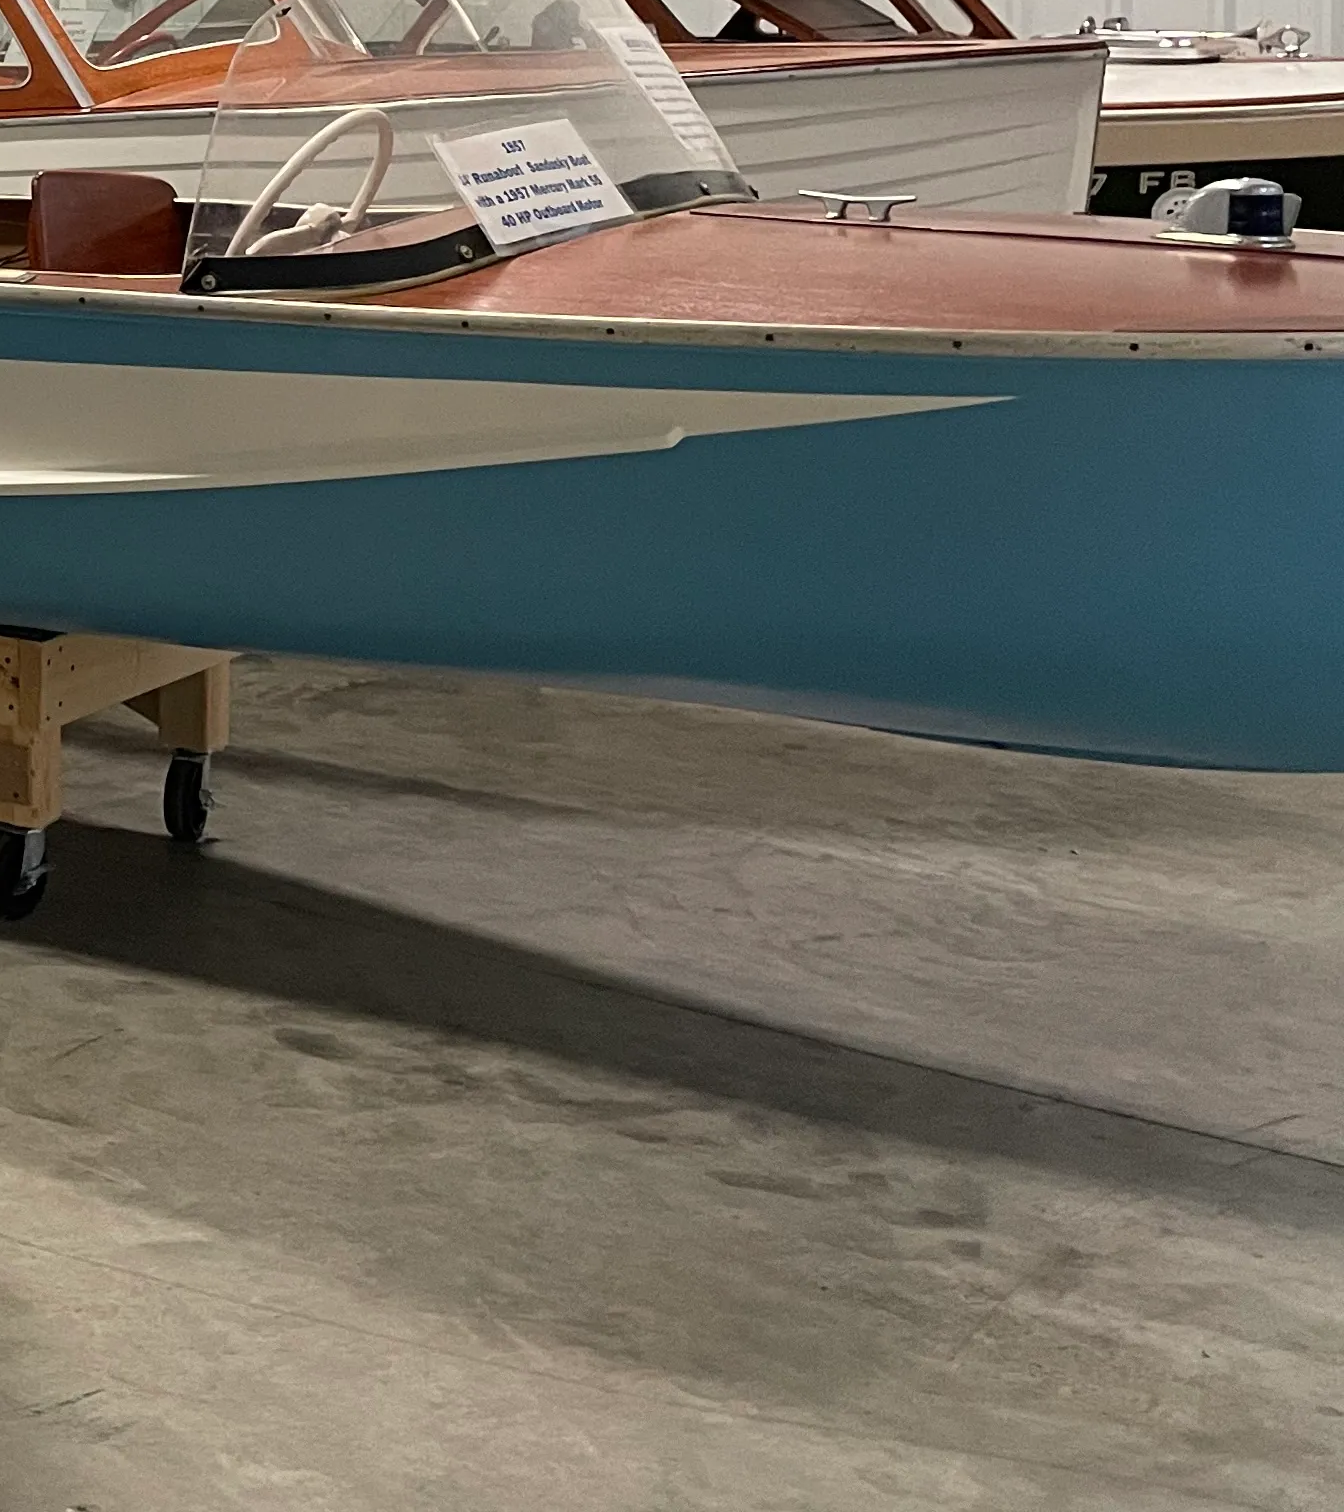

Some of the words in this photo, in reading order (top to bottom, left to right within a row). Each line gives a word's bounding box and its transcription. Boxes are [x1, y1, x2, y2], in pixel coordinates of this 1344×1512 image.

[472, 164, 525, 185] Runabout
[497, 194, 505, 204] a
[503, 187, 531, 203] 1957
[566, 177, 591, 188] Mark
[501, 214, 517, 228] 40
[517, 211, 532, 224] HP
[533, 201, 579, 220] Outboard
[575, 198, 604, 213] Motor
